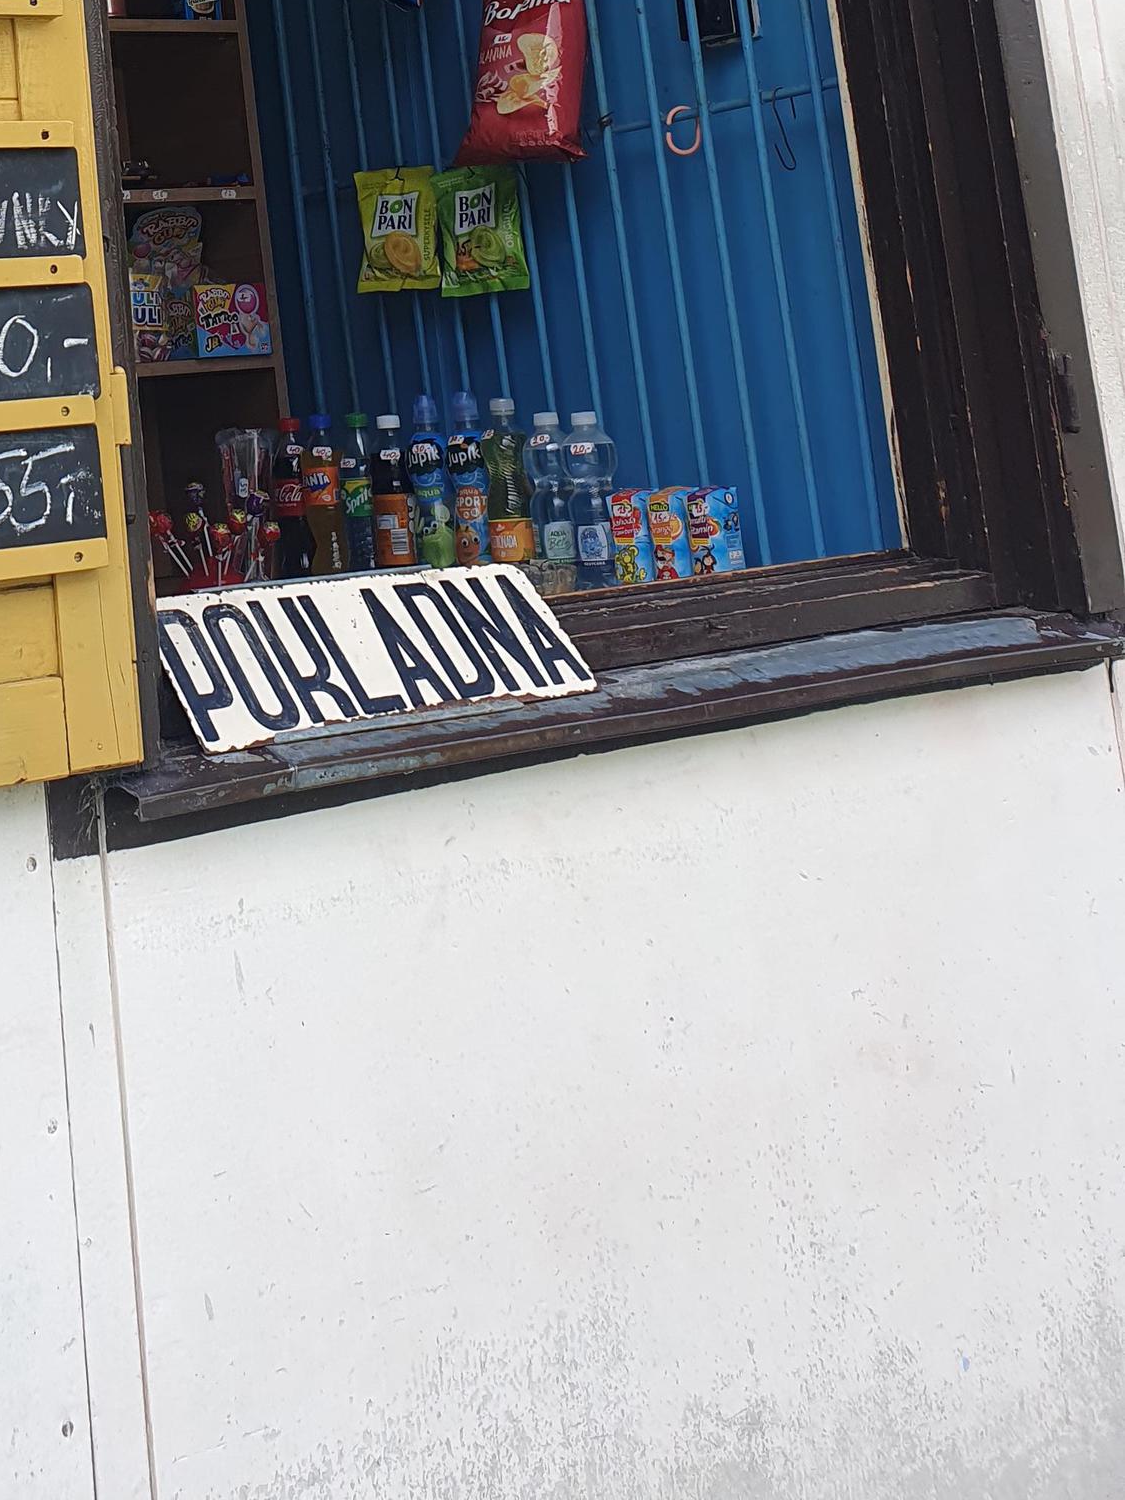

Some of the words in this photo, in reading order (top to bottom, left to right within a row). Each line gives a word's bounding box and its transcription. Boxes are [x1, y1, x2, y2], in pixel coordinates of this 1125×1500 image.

[380, 198, 415, 215] BON
[459, 187, 494, 213] BON
[377, 214, 413, 231] PARI
[459, 207, 491, 229] PARI
[157, 574, 591, 743] POKLADNA
